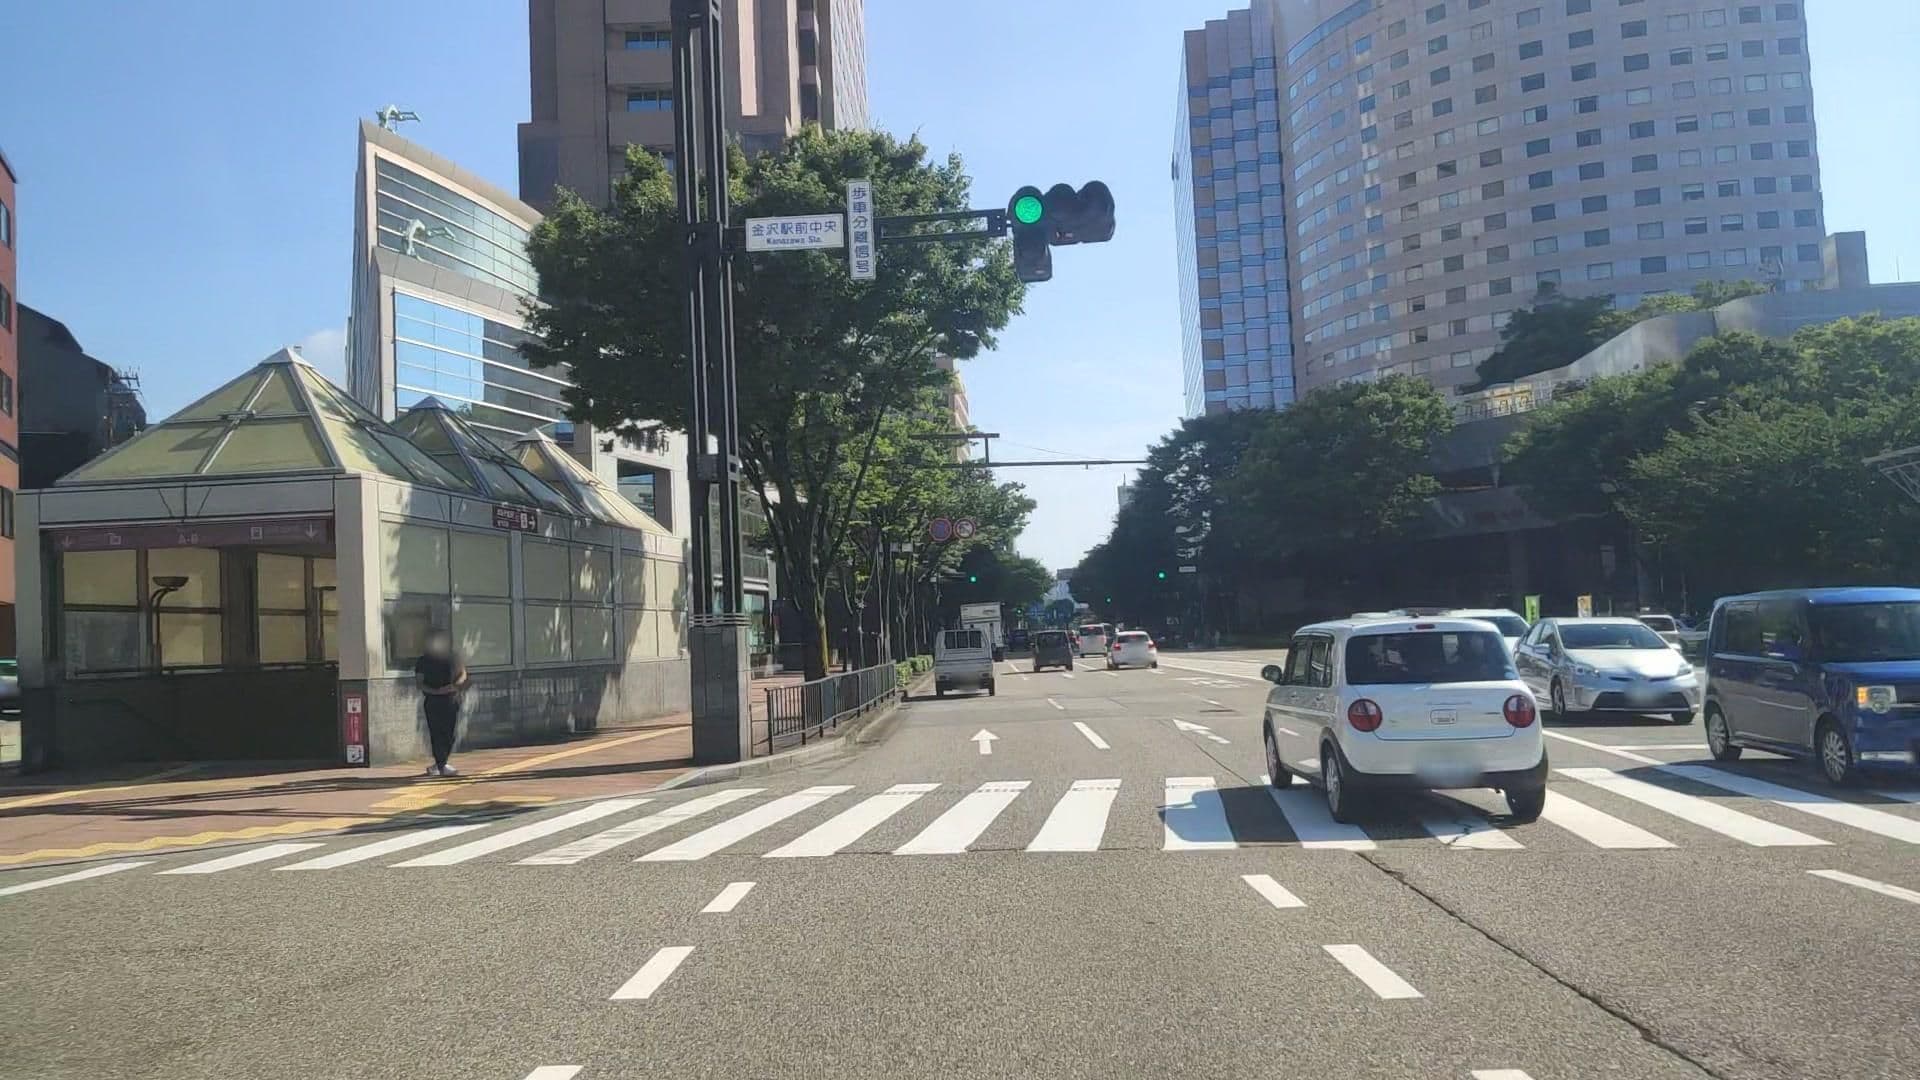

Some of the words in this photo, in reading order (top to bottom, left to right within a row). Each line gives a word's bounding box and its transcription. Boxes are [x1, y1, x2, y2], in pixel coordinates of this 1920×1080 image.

[751, 220, 837, 237] 金沢駅前中央
[851, 186, 870, 274] 歩車分離信号
[766, 237, 805, 245] Kanazawa
